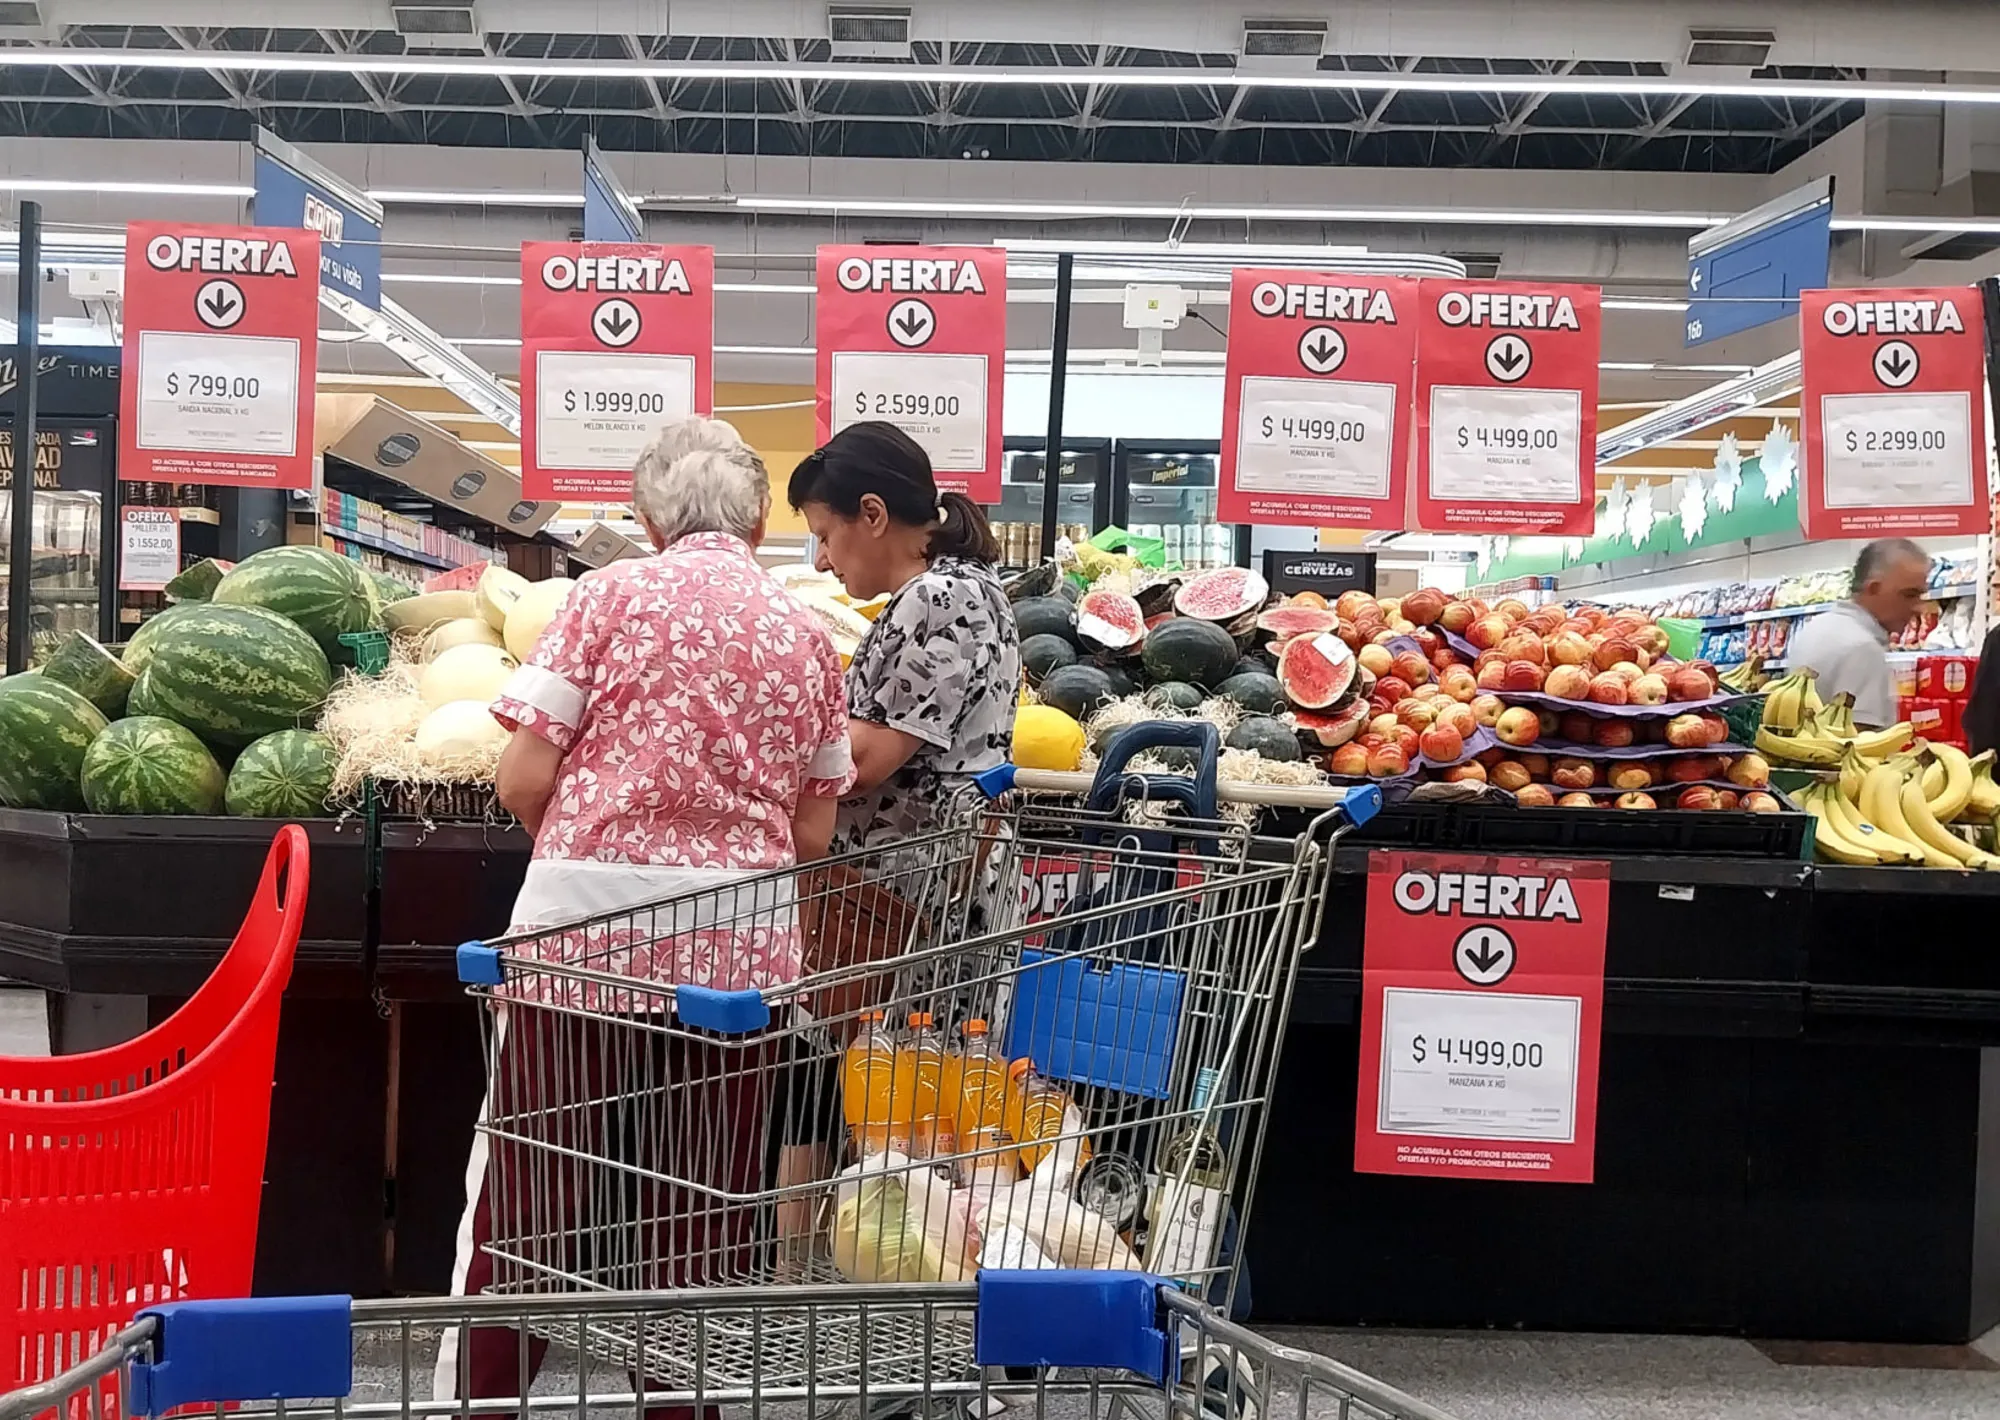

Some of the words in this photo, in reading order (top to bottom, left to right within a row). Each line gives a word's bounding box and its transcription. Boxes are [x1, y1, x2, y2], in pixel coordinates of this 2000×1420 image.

[147, 235, 297, 277] OFERTA
[332, 260, 341, 280] su
[342, 263, 362, 290] visita
[542, 256, 692, 294] OFERTA
[837, 257, 986, 294] OFERTA
[1252, 281, 1397, 325] OFERTA
[1437, 292, 1580, 330] OFERTA
[1687, 319, 1702, 340] 16b
[1823, 300, 1965, 336] OFERTA
[68, 364, 119, 378] TIME
[167, 372, 179, 396] $
[188, 374, 260, 400] 799,00
[564, 389, 576, 412] $
[584, 391, 663, 415] 1.999,00
[856, 391, 866, 414] $
[876, 393, 959, 417] 2.599,00
[584, 423, 604, 431] MELON
[605, 423, 630, 431] BLANCO
[637, 424, 646, 432] KG
[1262, 415, 1273, 438] $
[1282, 417, 1364, 443] 4.499,00
[1457, 425, 1469, 448] $
[1477, 427, 1558, 450] 4.499,00
[1289, 449, 1319, 458] MANZANA
[1846, 430, 1857, 452] $
[1866, 430, 1945, 452] 2.299,00
[1152, 464, 1189, 483] Imperial
[128, 511, 174, 523] OFERTA
[129, 537, 134, 548] $
[1284, 566, 1353, 576] CERVEZAS
[1393, 870, 1582, 922] OFERTA
[1412, 1034, 1426, 1063] $
[1438, 1038, 1542, 1070] 4.499,00
[1448, 1077, 1485, 1087] MANZANA
[1487, 1079, 1493, 1088] X
[1495, 1079, 1506, 1089] KG
[1397, 1154, 1429, 1163] OFERTAS
[1430, 1156, 1446, 1165] Y/O
[1447, 1158, 1505, 1168] PROMOCIONES
[1506, 1160, 1550, 1170] BANCARIAS
[1412, 1146, 1451, 1156] ACUMULA
[1453, 1148, 1473, 1157] CON
[1474, 1149, 1500, 1159] OTROS
[1501, 1151, 1553, 1162] DESCUENTOS,
